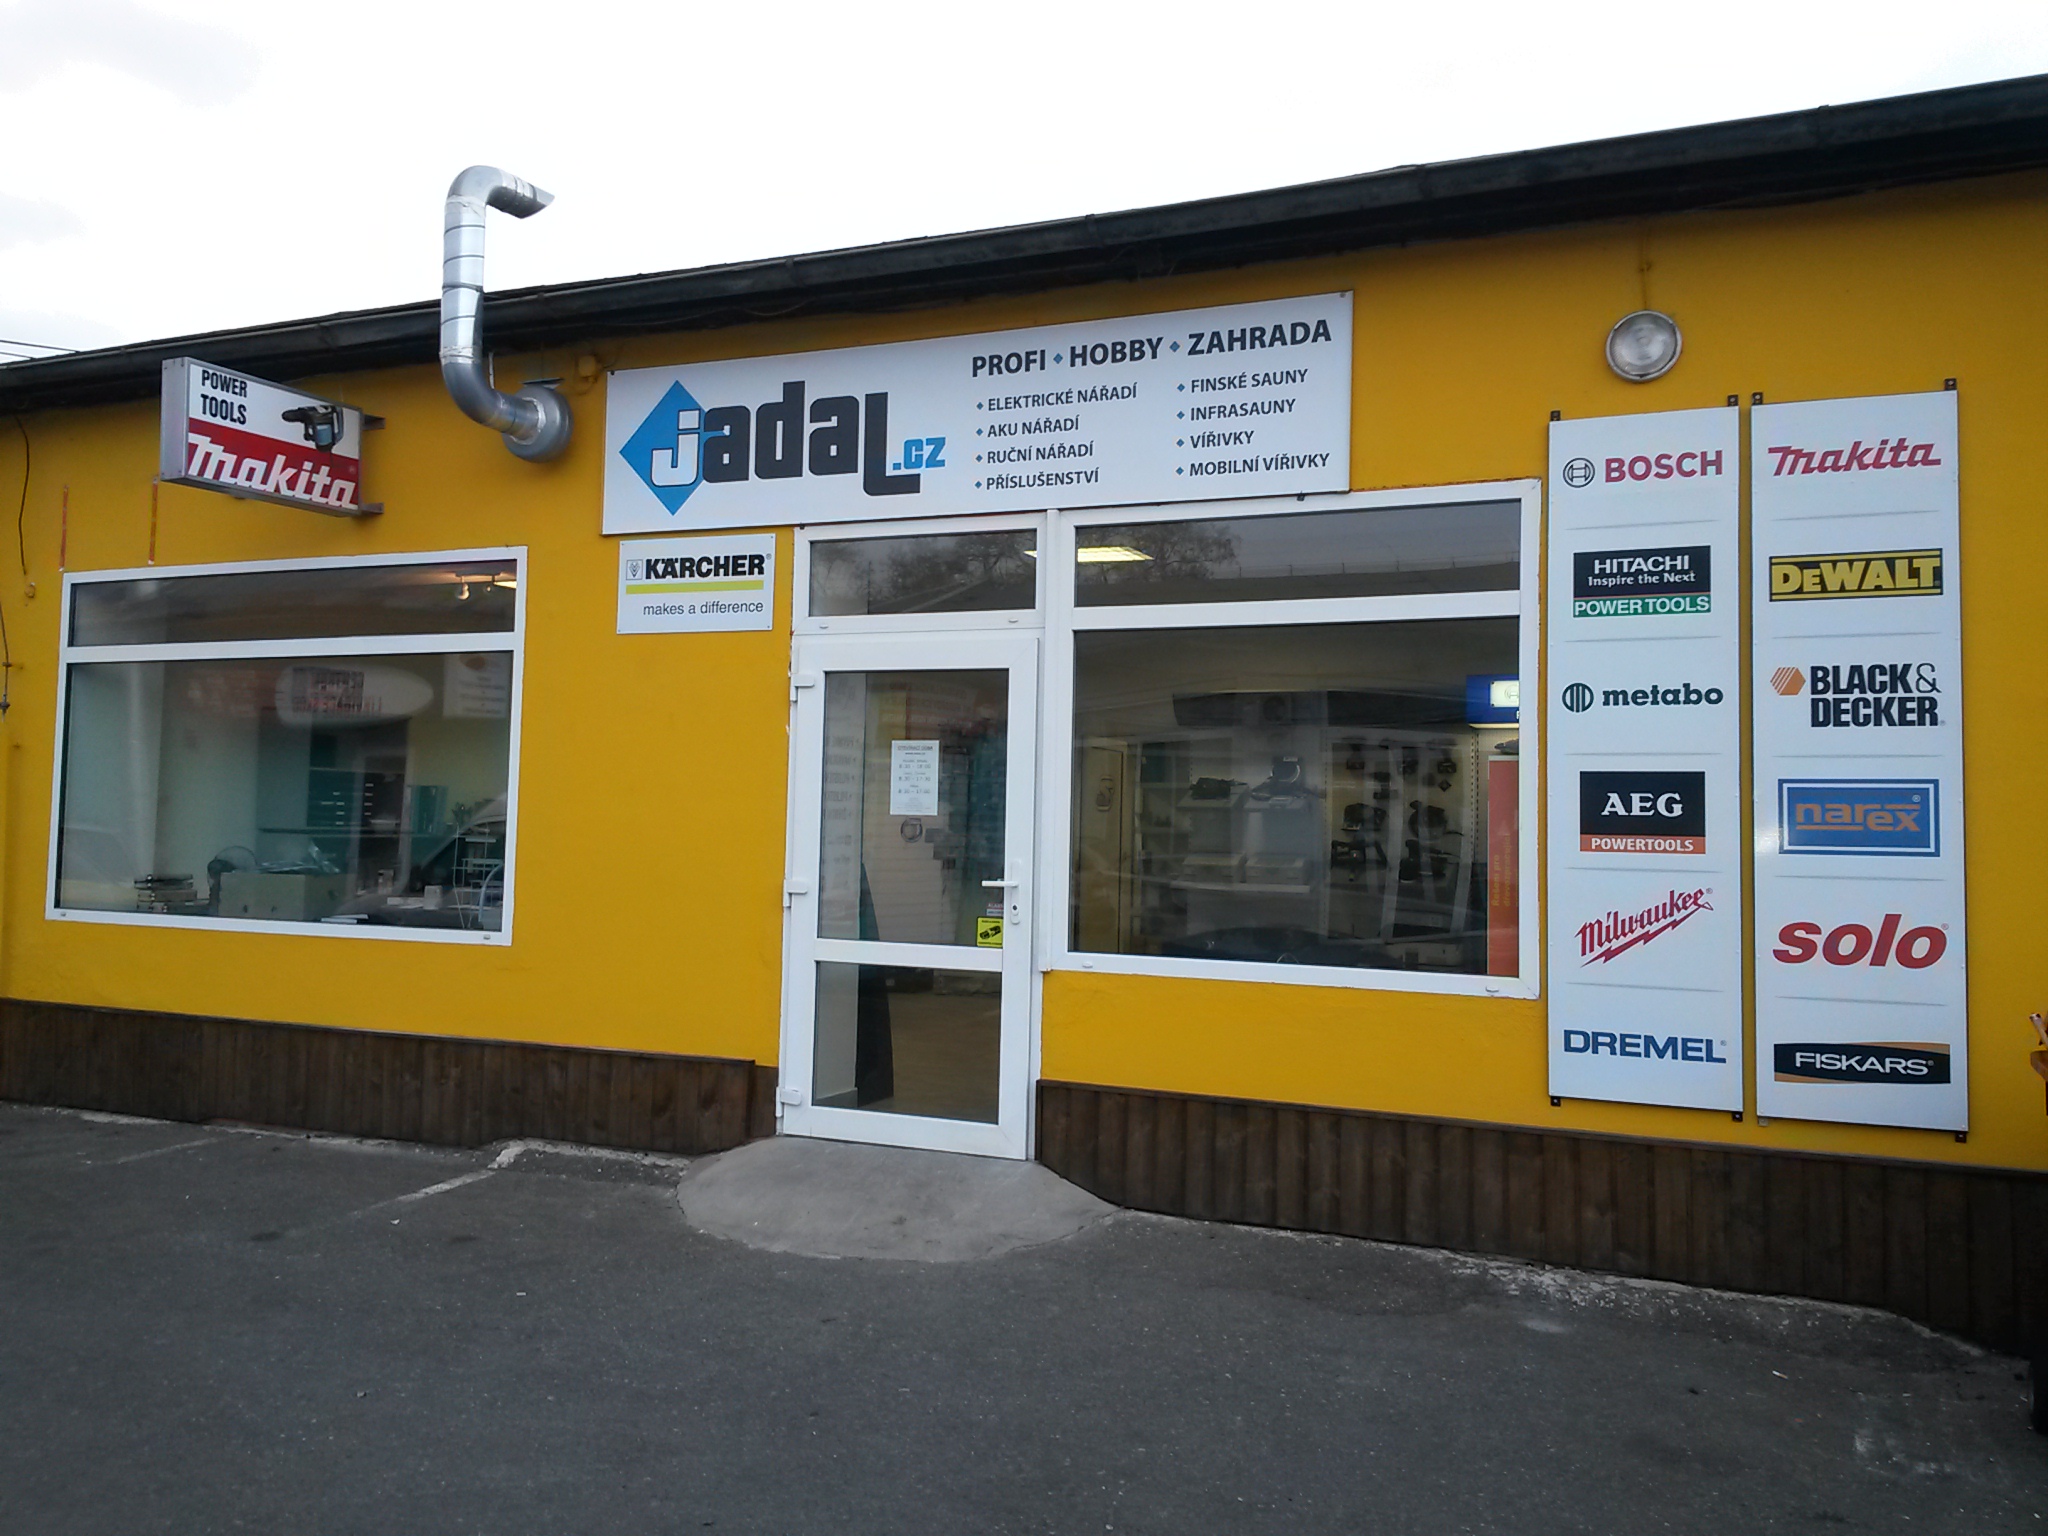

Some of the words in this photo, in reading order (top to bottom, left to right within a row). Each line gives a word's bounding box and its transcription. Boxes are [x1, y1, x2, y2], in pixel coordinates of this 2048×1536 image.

[971, 349, 1046, 378] PROFI
[1069, 336, 1164, 368] HOBBY
[1187, 319, 1332, 356] ZAHRADA
[201, 369, 248, 398] POWER
[1190, 371, 1247, 393] FINSKÉ
[1251, 368, 1309, 388] SAUNY
[200, 393, 247, 425] TOOLS
[988, 388, 1074, 412] ELEKTRICKÉ
[1077, 382, 1137, 404] NÁŘADÍ
[1190, 398, 1296, 421] INFRASAUNY
[987, 421, 1019, 438] AKU
[1021, 414, 1080, 435] NÁŘADÍ
[1190, 429, 1255, 449] VÍŘIVKY
[987, 444, 1033, 464] RUČNÍ
[1036, 440, 1094, 461] NÁŘADÍ
[1189, 454, 1260, 477] MOBILNÍ
[1262, 452, 1331, 472] VÍŘIVKY
[986, 467, 1100, 490] PŘÍSLUŠENSTVÍ
[1604, 450, 1723, 483] BOSCH
[645, 553, 765, 580] KÄRCHER
[1593, 555, 1690, 574] HITACHI
[1587, 574, 1635, 588] Inspire
[1638, 573, 1660, 585] the
[1663, 570, 1696, 583] Next
[643, 601, 685, 616] makes
[688, 603, 697, 615] a
[700, 600, 764, 615] difference
[1574, 598, 1643, 616] POWER
[1644, 596, 1710, 613] TOOLS
[1602, 682, 1724, 706] metabo
[1810, 696, 1939, 728] DECKER
[1600, 791, 1683, 817] AEG
[1795, 801, 1921, 832] narex
[1590, 837, 1694, 852] POWERTOOLS
[1574, 887, 1706, 958] Milwaukee
[1772, 913, 1948, 969] solo
[1563, 1028, 1727, 1064] DREMEL
[1795, 1051, 1929, 1076] FISKARS
